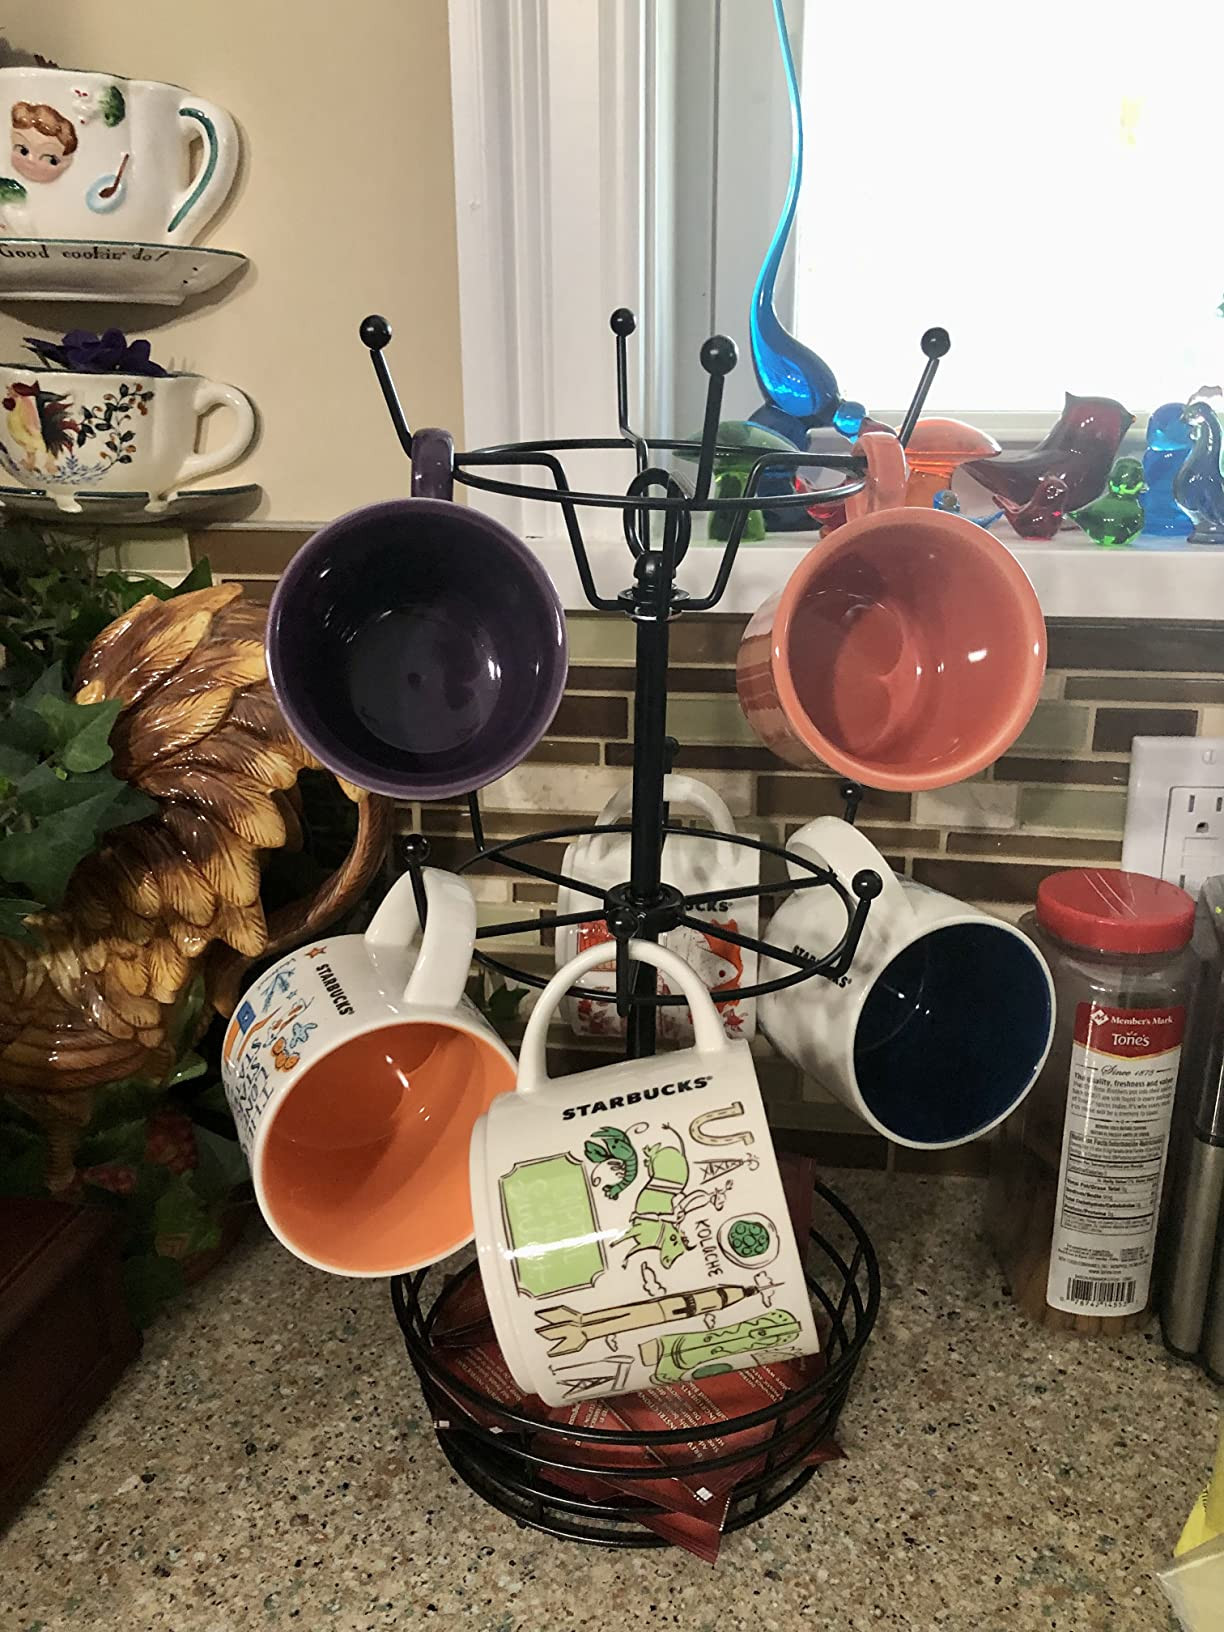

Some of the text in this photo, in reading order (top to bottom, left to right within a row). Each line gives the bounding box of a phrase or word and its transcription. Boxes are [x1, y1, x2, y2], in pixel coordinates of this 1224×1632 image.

[0, 243, 50, 259] Good
[315, 963, 354, 1015] STARBUCKS
[1110, 1016, 1174, 1025] Member's Mark
[1112, 1032, 1150, 1046] Tone's
[1101, 1064, 1131, 1076] Since
[562, 1077, 710, 1120] STARBUCKS
